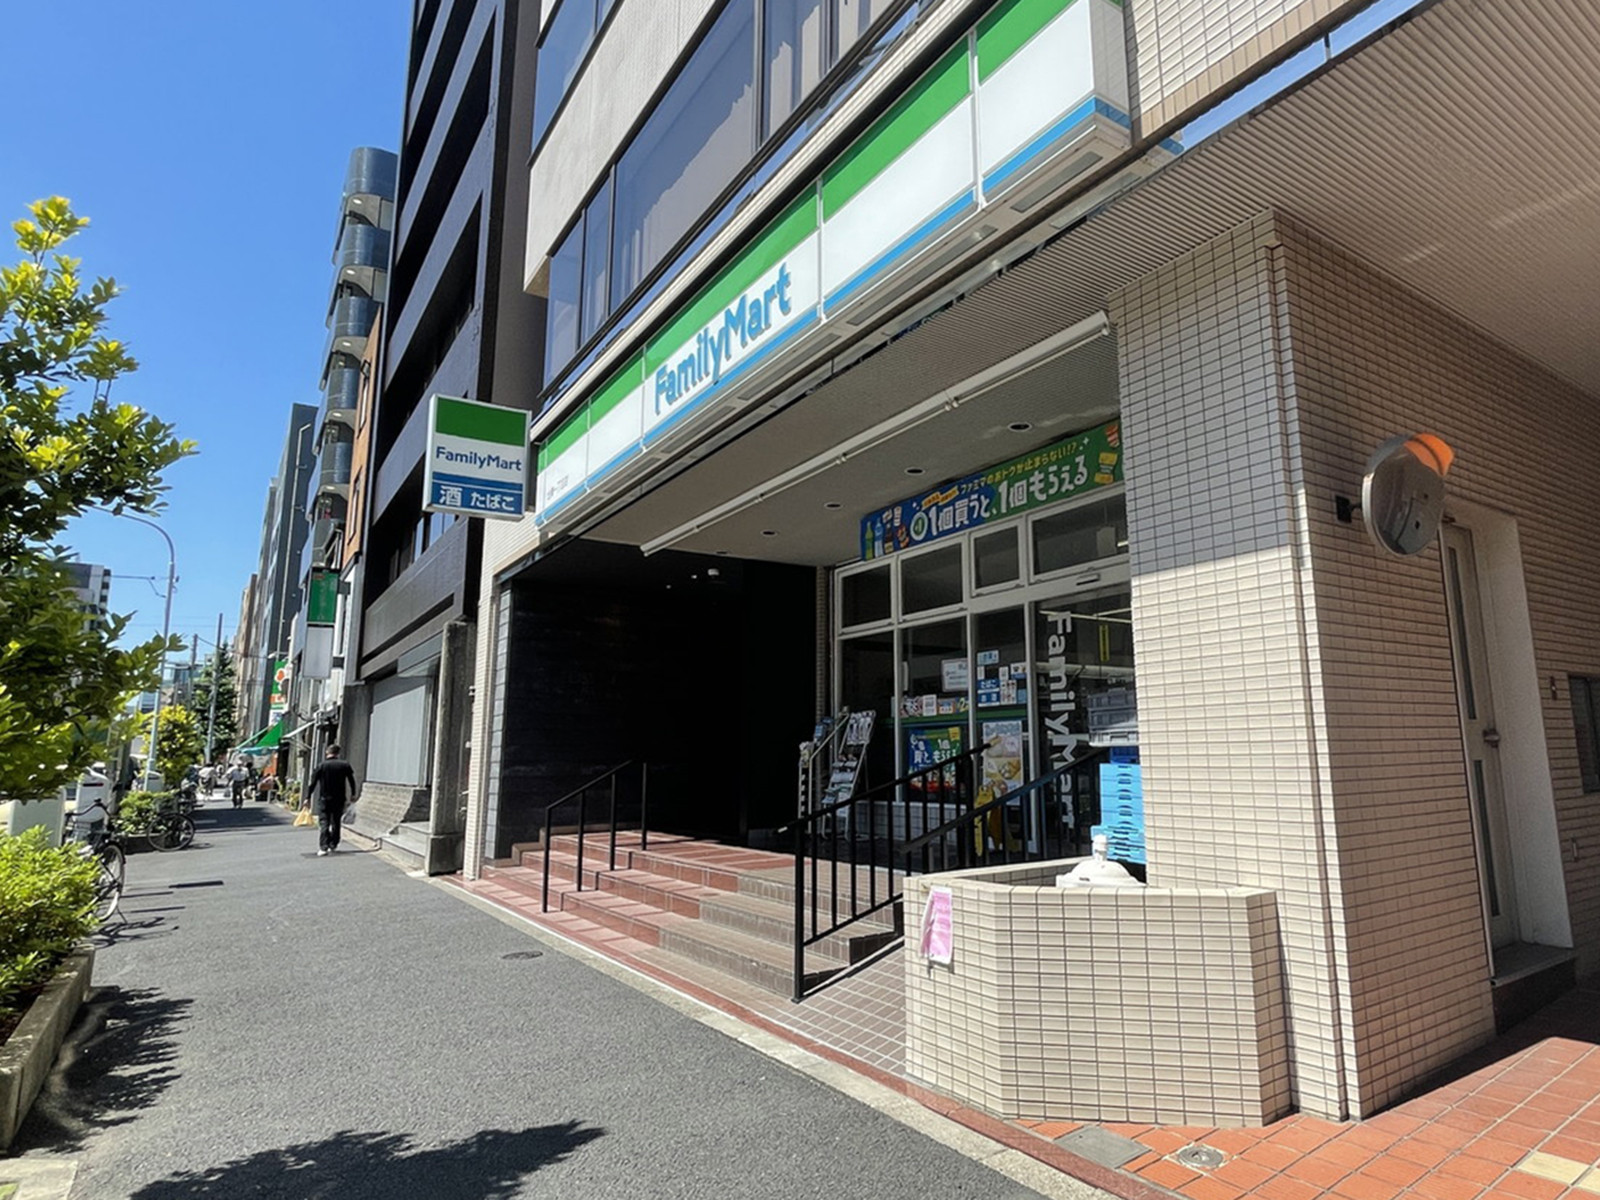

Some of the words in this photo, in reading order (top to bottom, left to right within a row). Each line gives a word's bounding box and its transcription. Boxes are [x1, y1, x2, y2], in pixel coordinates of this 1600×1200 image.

[655, 262, 792, 415] FamilyMart
[436, 446, 522, 472] FamilyMart
[439, 485, 463, 507] 酒
[471, 491, 515, 511] たばこ
[1045, 611, 1077, 828] FamilyMart
